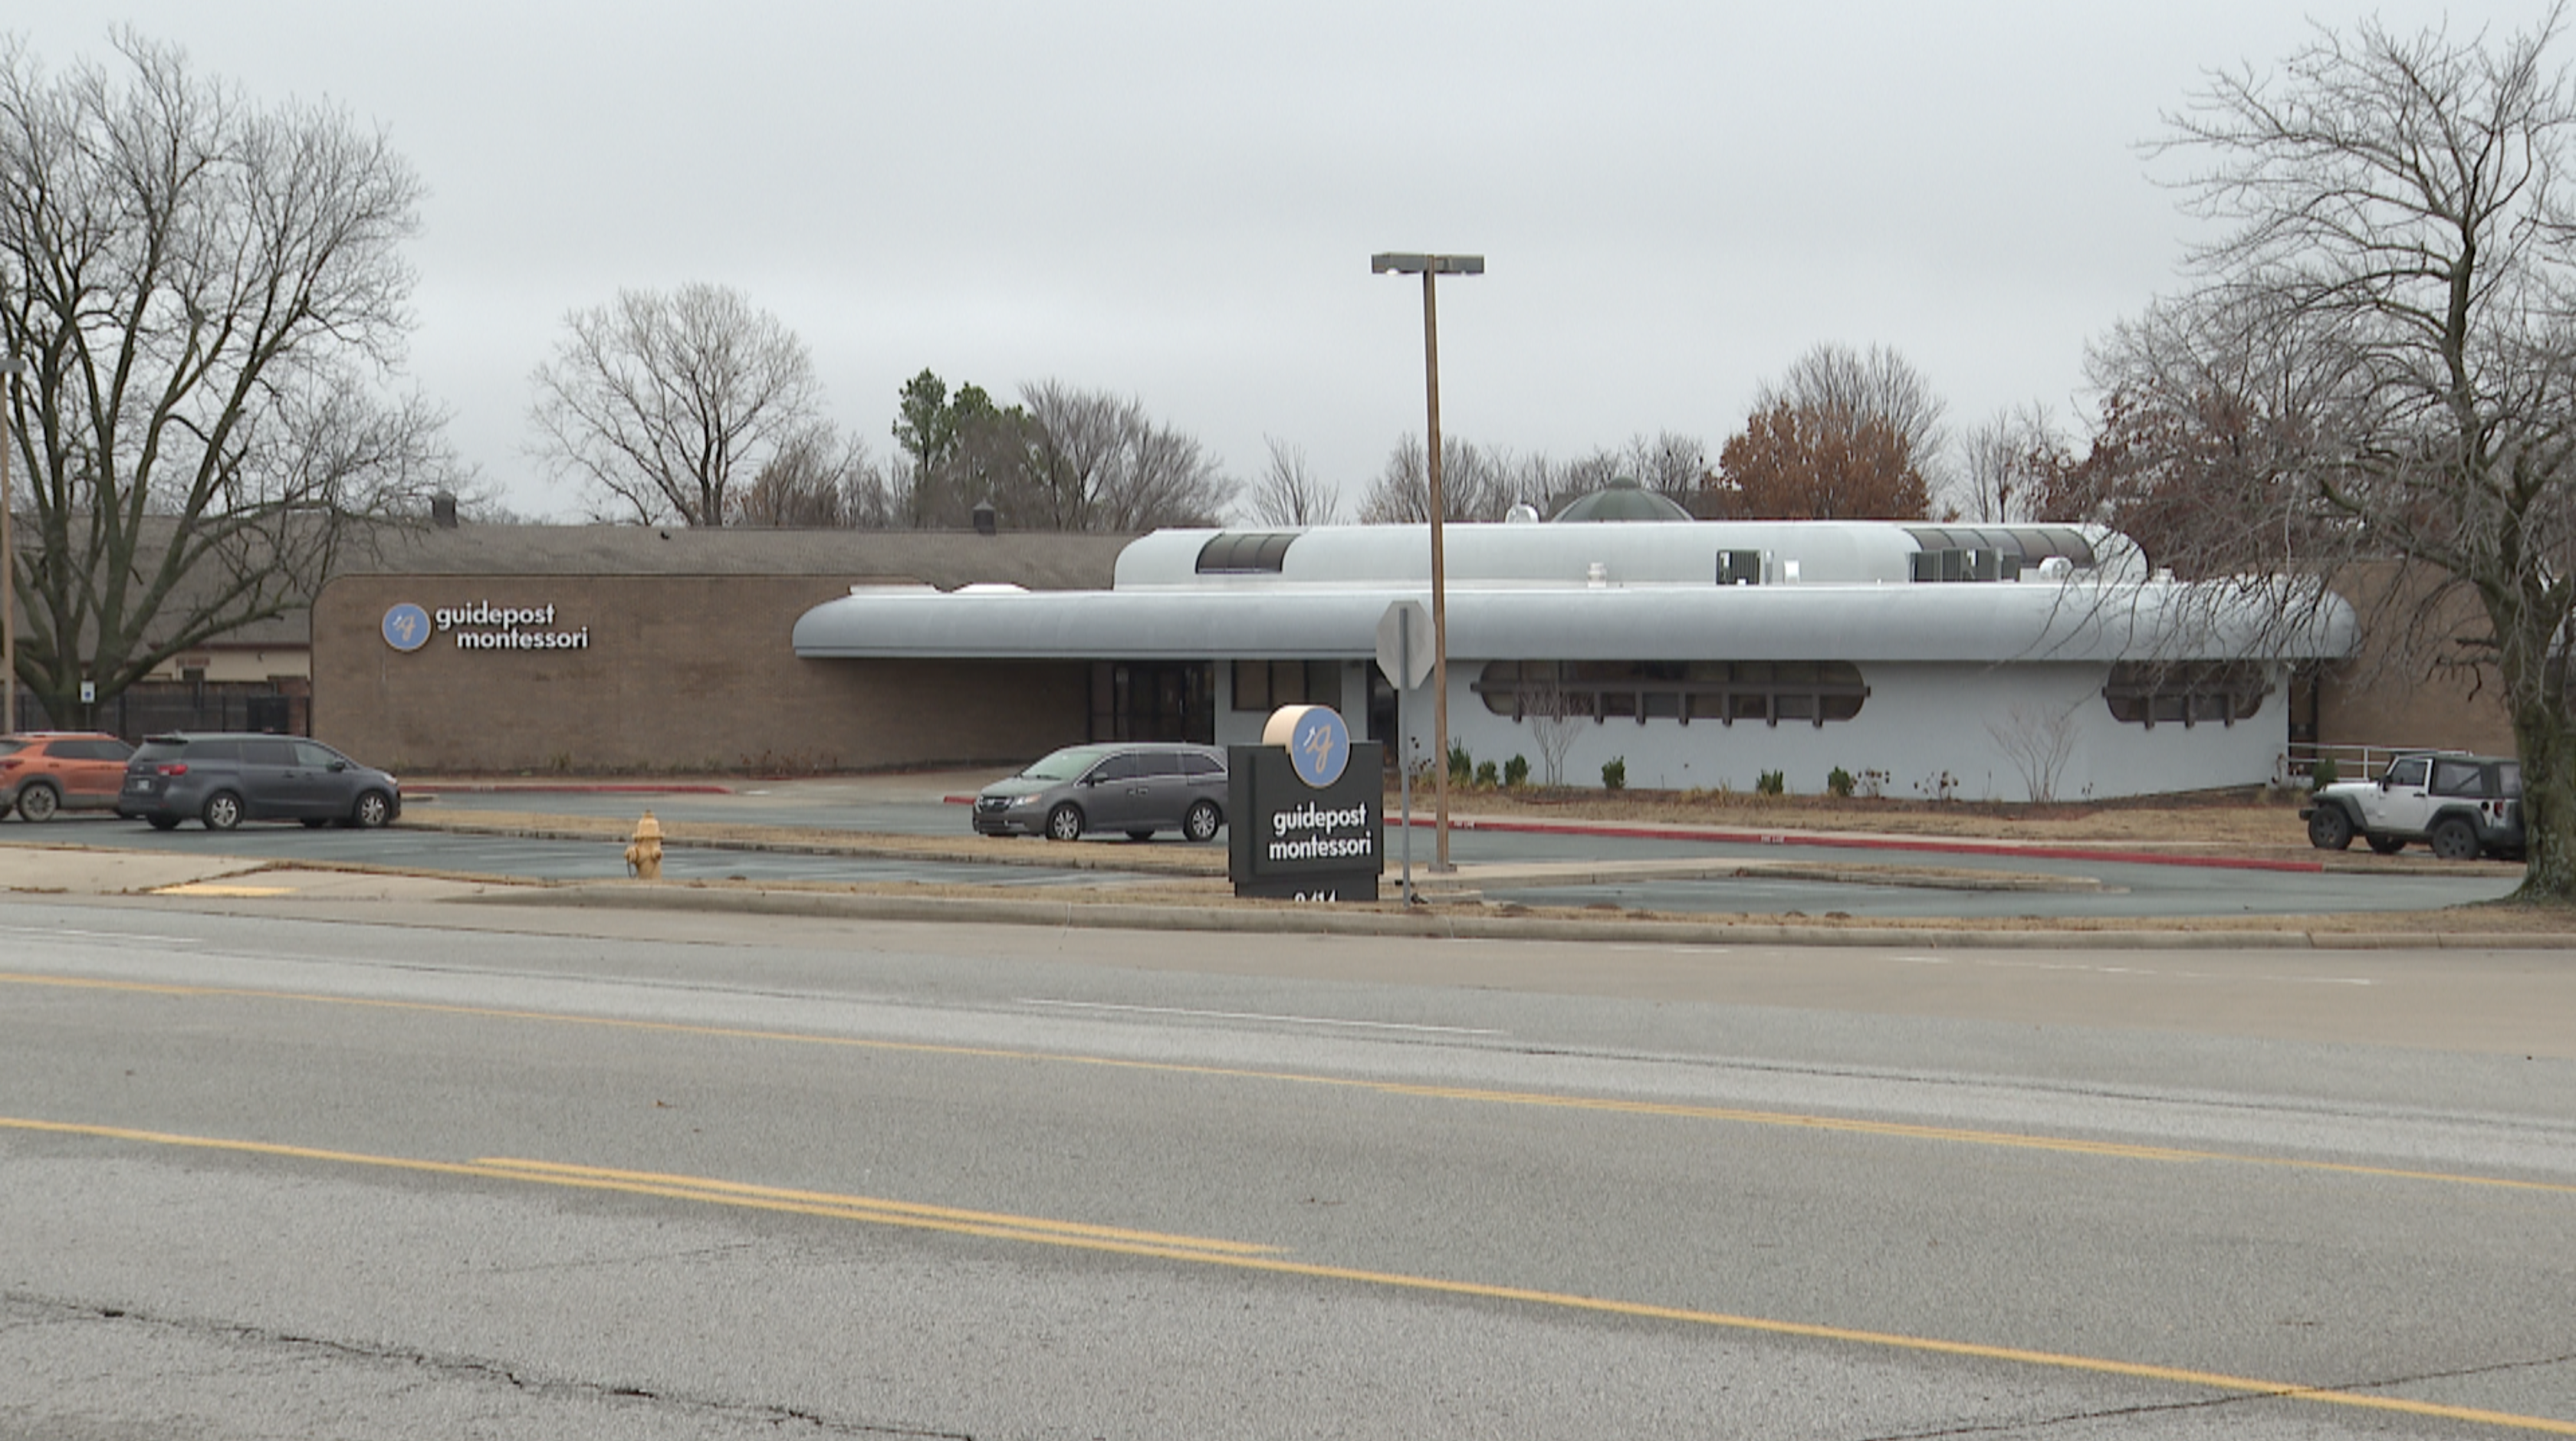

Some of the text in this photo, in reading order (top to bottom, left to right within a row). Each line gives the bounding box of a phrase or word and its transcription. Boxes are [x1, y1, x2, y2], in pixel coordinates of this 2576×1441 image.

[435, 599, 555, 631] guidepost
[457, 626, 588, 648] montessori
[1273, 800, 1366, 836] guidepost
[1268, 829, 1372, 860] montessori
